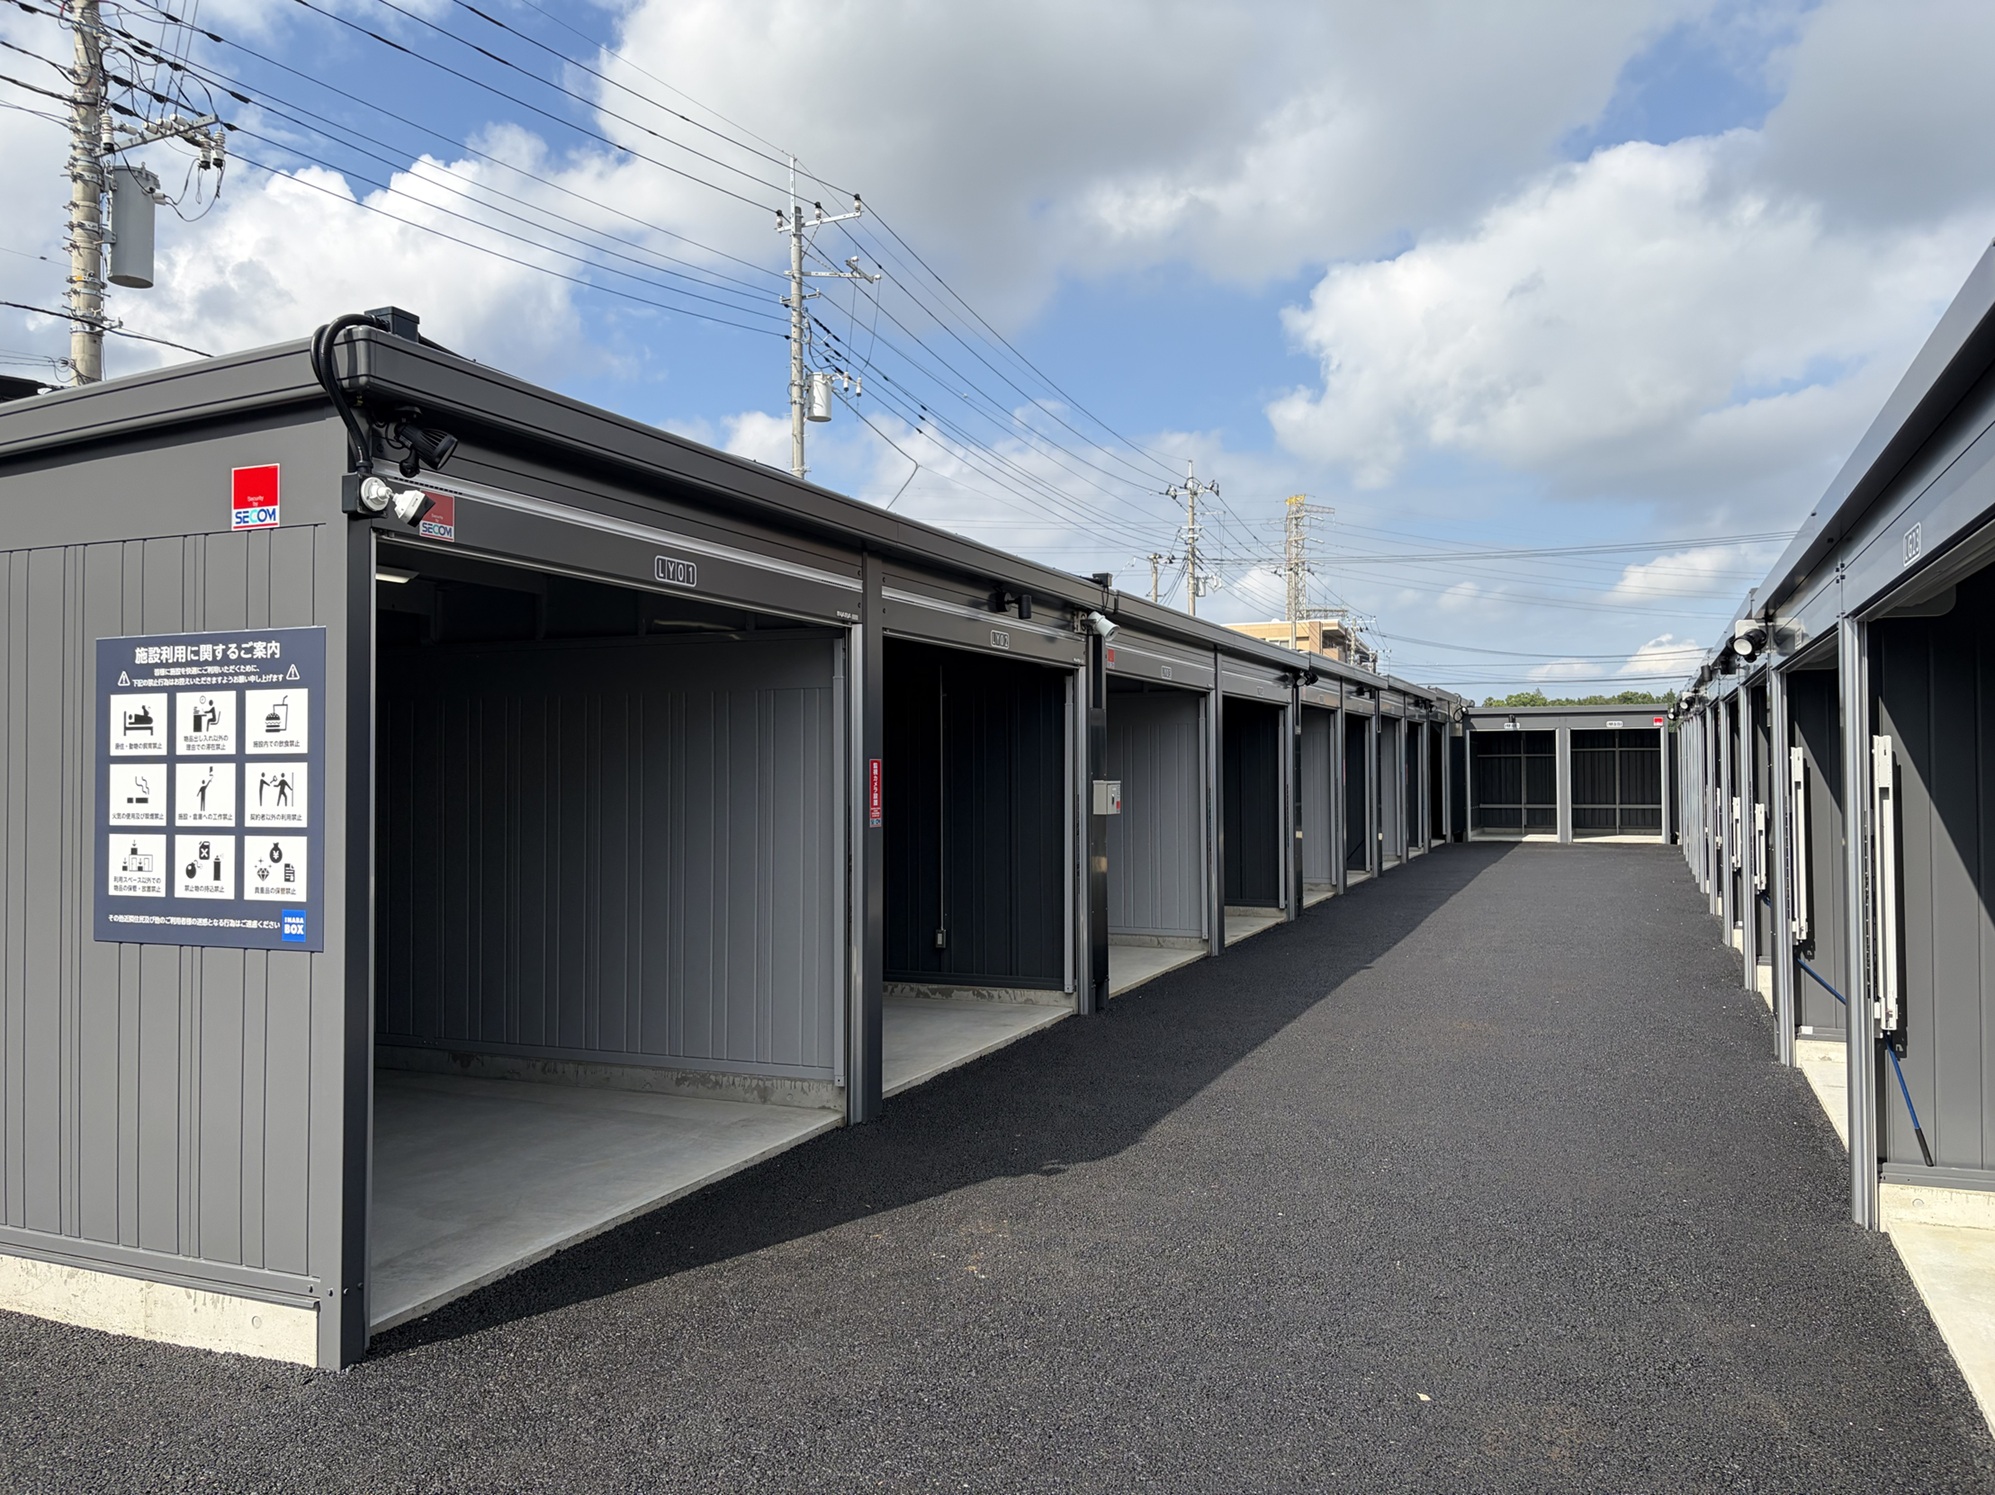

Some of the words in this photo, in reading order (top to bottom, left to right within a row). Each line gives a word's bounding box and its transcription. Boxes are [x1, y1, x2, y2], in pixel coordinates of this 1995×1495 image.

[235, 508, 277, 524] SECOM
[422, 522, 453, 538] SECOM
[658, 559, 694, 583] LY01
[135, 640, 280, 664] 施設利用に関するご案内
[253, 740, 300, 748] 施設内での飲食禁止
[250, 813, 302, 822] 契約者以外の利用禁止
[113, 875, 162, 884] 利用スペース以外での
[184, 885, 225, 893] 禁止物の持込禁止
[254, 886, 297, 895] 貴重品の保管禁止
[284, 916, 304, 924] INABA
[284, 924, 305, 935] BOX
